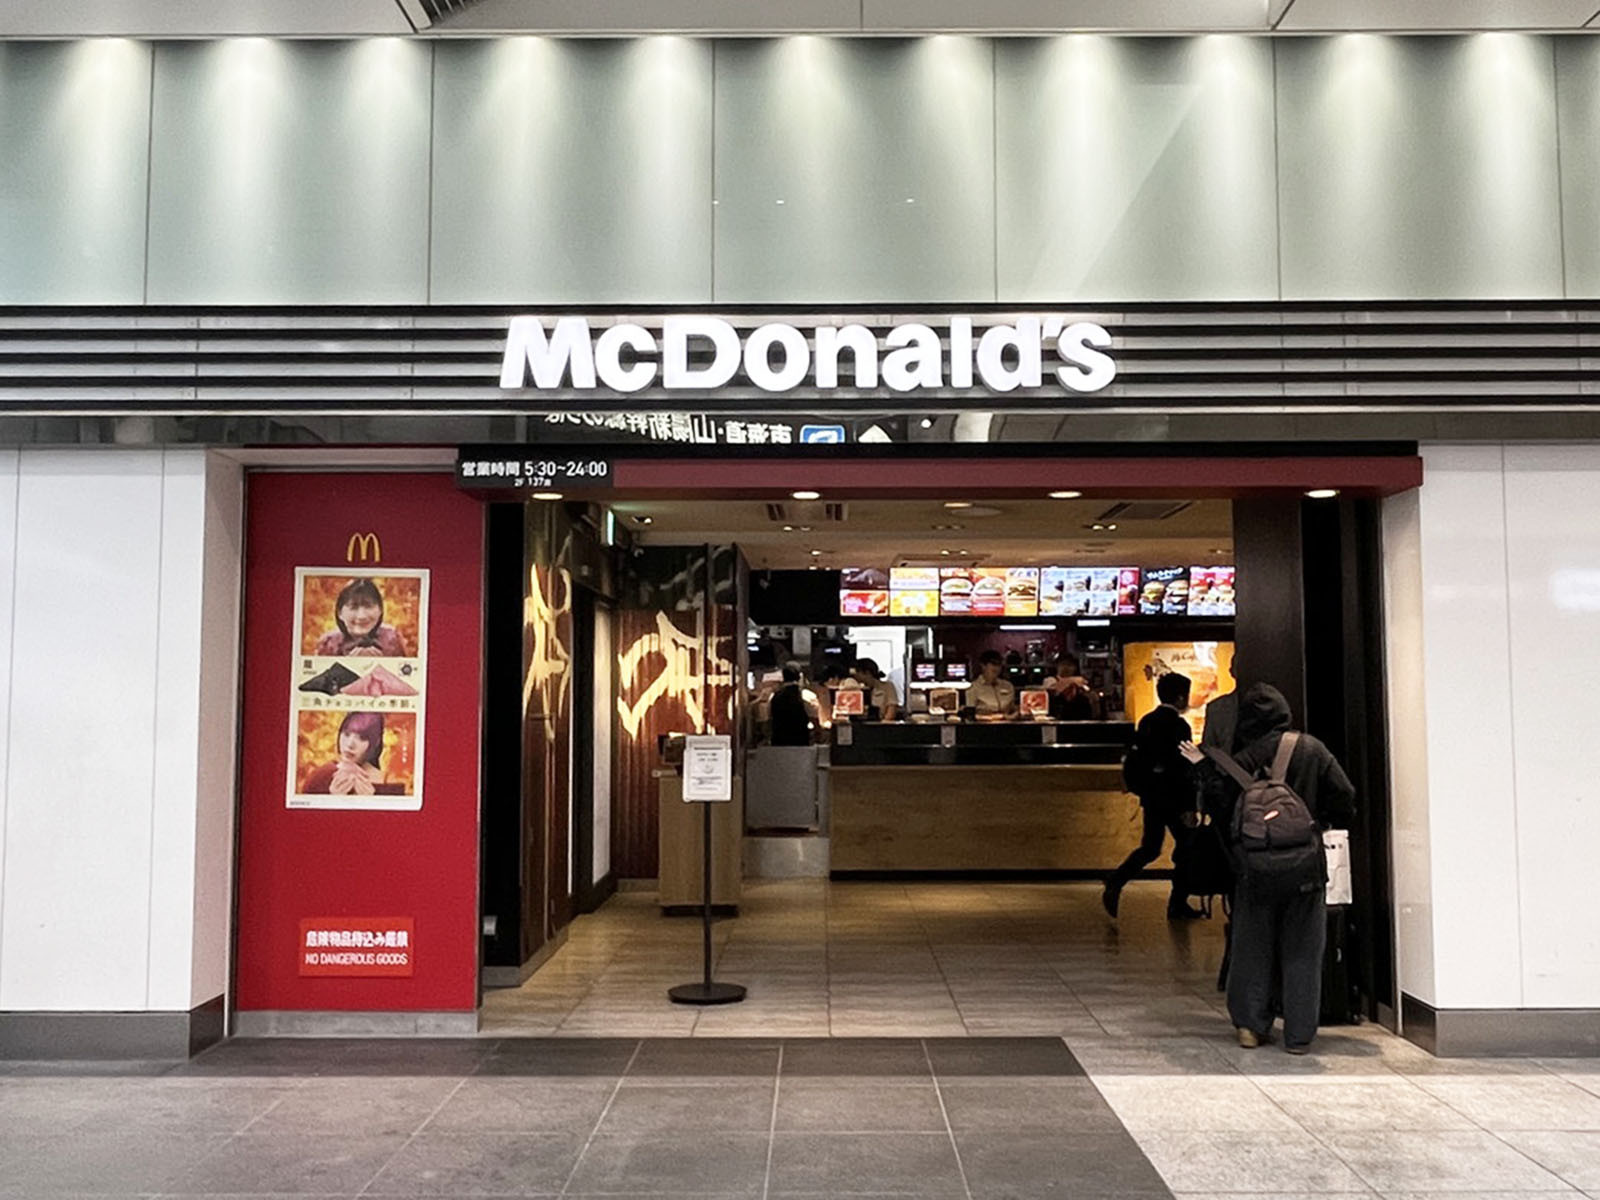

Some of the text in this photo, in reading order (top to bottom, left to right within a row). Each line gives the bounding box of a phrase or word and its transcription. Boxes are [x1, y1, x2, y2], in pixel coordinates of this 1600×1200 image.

[500, 316, 1117, 393] McDonald's
[462, 461, 521, 477] 営業時間
[305, 952, 408, 966] NO DANGEROUS GOODS
